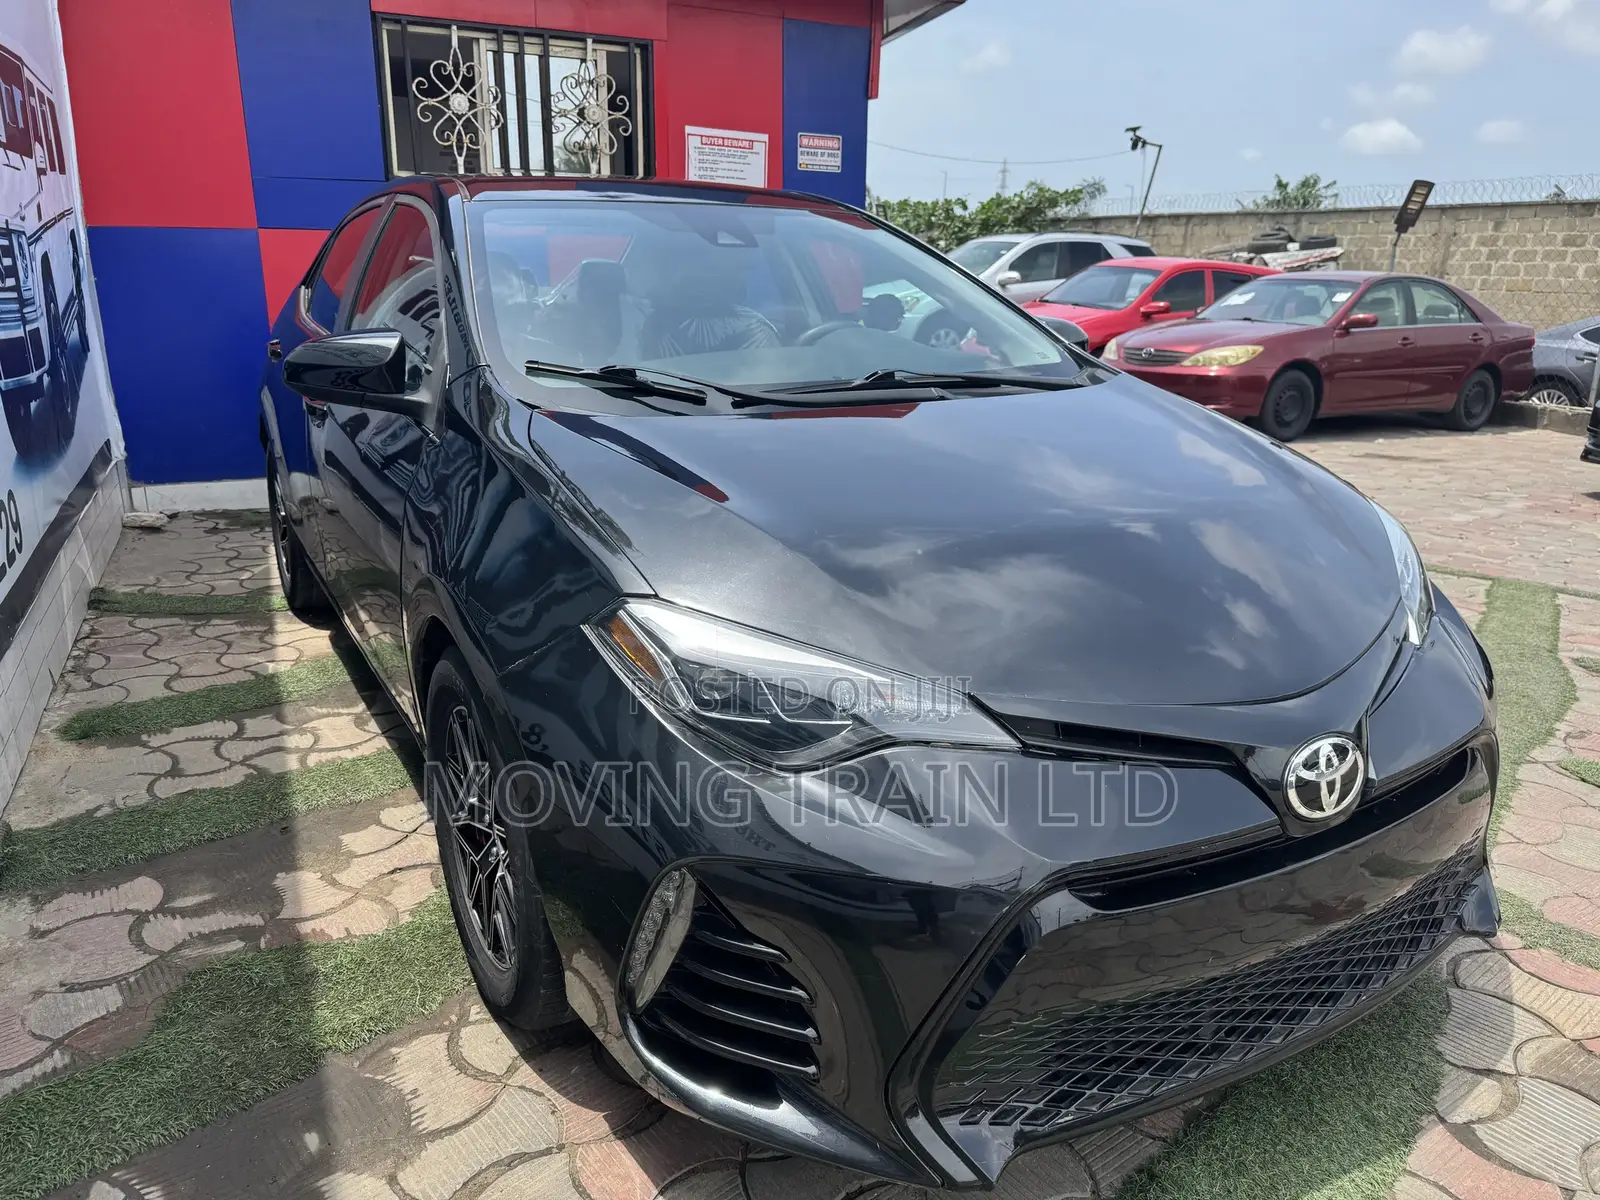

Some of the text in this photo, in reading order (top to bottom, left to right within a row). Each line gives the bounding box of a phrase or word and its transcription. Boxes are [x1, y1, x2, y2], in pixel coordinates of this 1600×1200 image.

[702, 136, 753, 149] BUYER BEWARE!
[802, 138, 839, 148] WARNING
